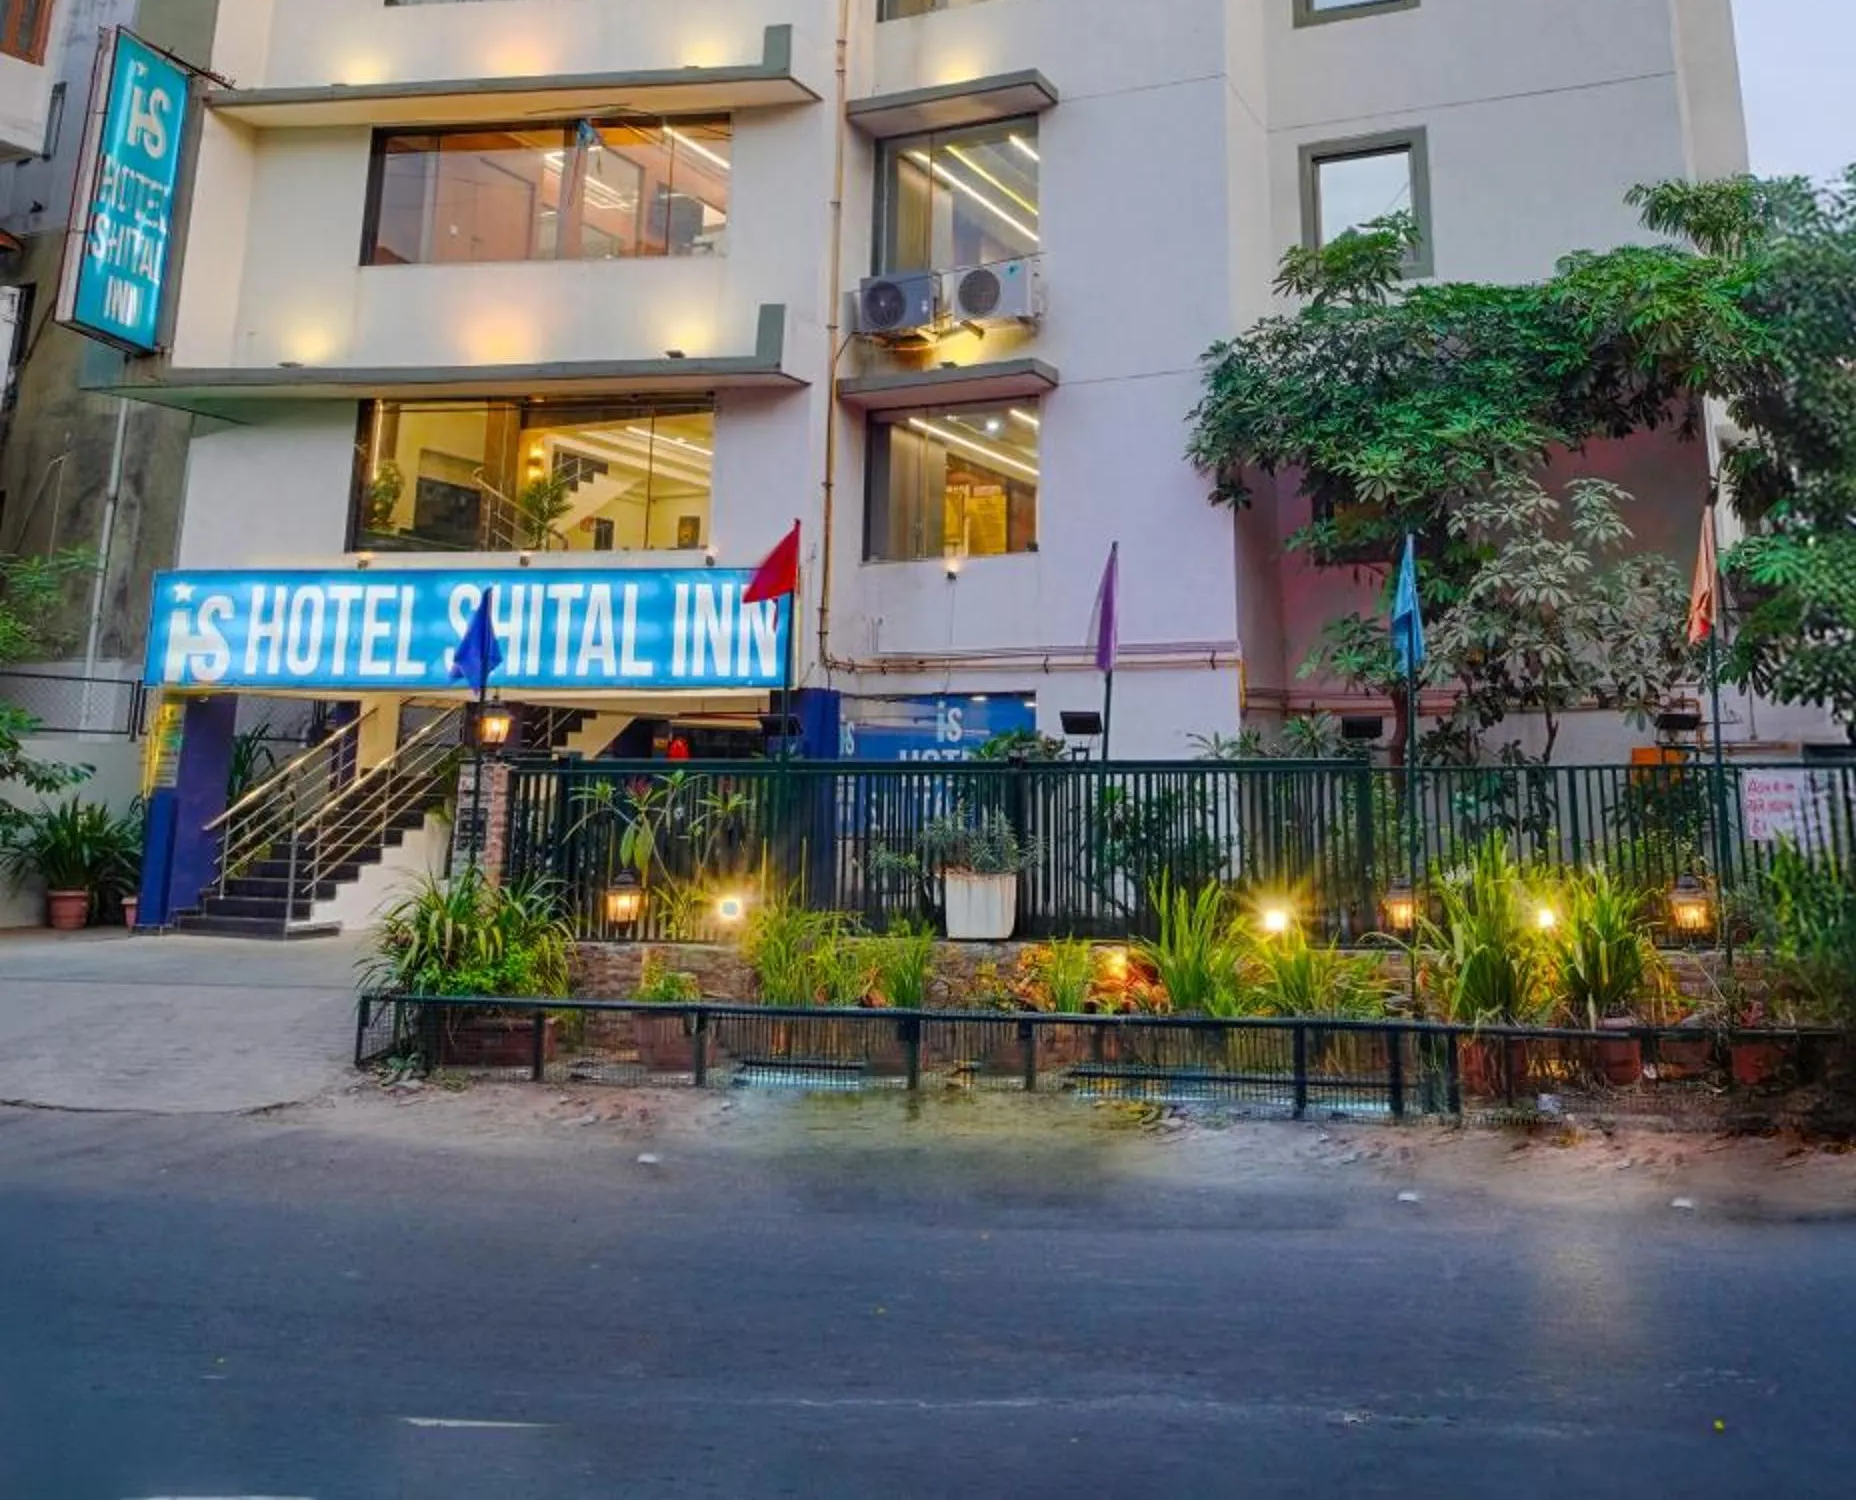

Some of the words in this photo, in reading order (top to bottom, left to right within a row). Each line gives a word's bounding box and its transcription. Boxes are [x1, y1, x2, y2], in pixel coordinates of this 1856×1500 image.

[91, 212, 166, 285] SHITAL
[104, 275, 145, 327] INN
[246, 585, 426, 676] HOTEL
[443, 583, 654, 676] SHITAL
[673, 583, 777, 676] INN
